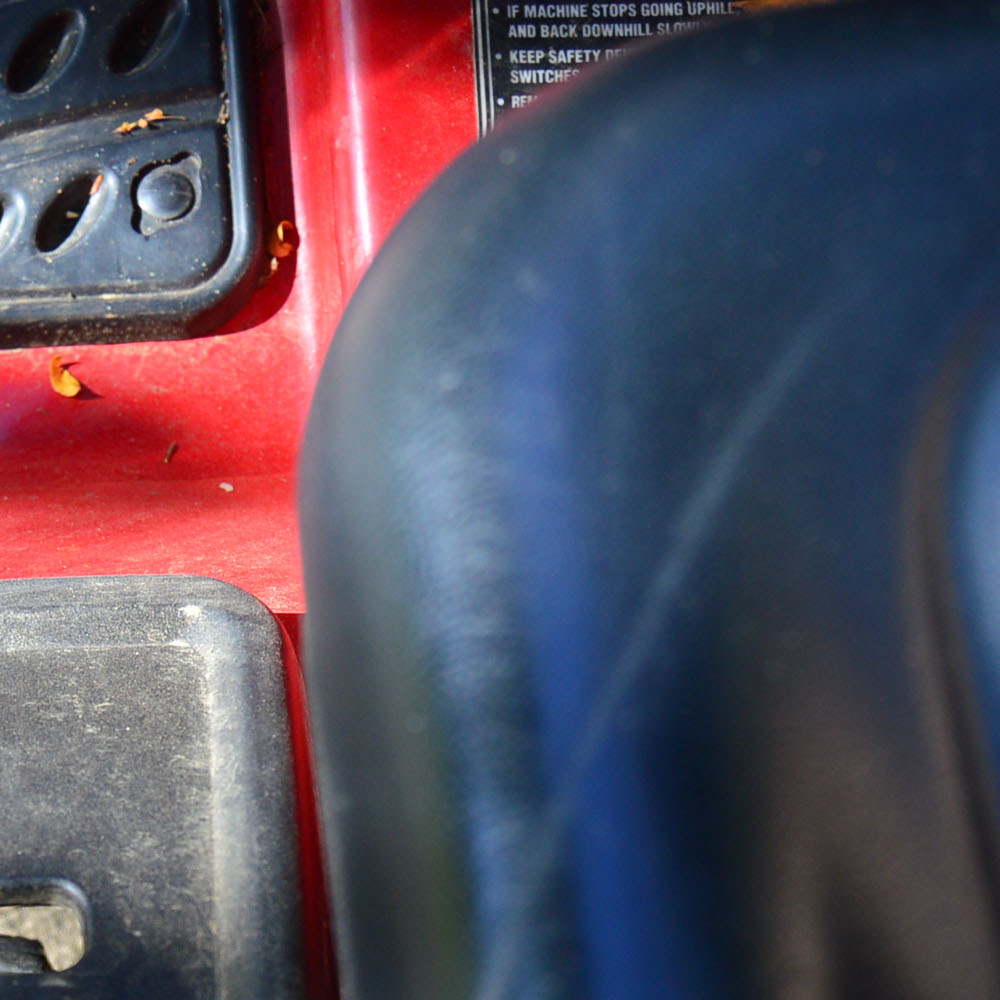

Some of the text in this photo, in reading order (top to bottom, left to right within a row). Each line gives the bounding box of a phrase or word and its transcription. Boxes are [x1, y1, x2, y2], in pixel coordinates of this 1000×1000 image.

[507, 5, 517, 18] IF
[524, 4, 588, 18] MACHINE
[592, 3, 637, 17] STOPS
[641, 3, 683, 16] GOING
[508, 24, 537, 38] AND
[540, 24, 578, 38] BACK
[582, 22, 653, 37] DOWNHILL
[509, 49, 545, 64] KEEP
[548, 49, 601, 64] SAFETY
